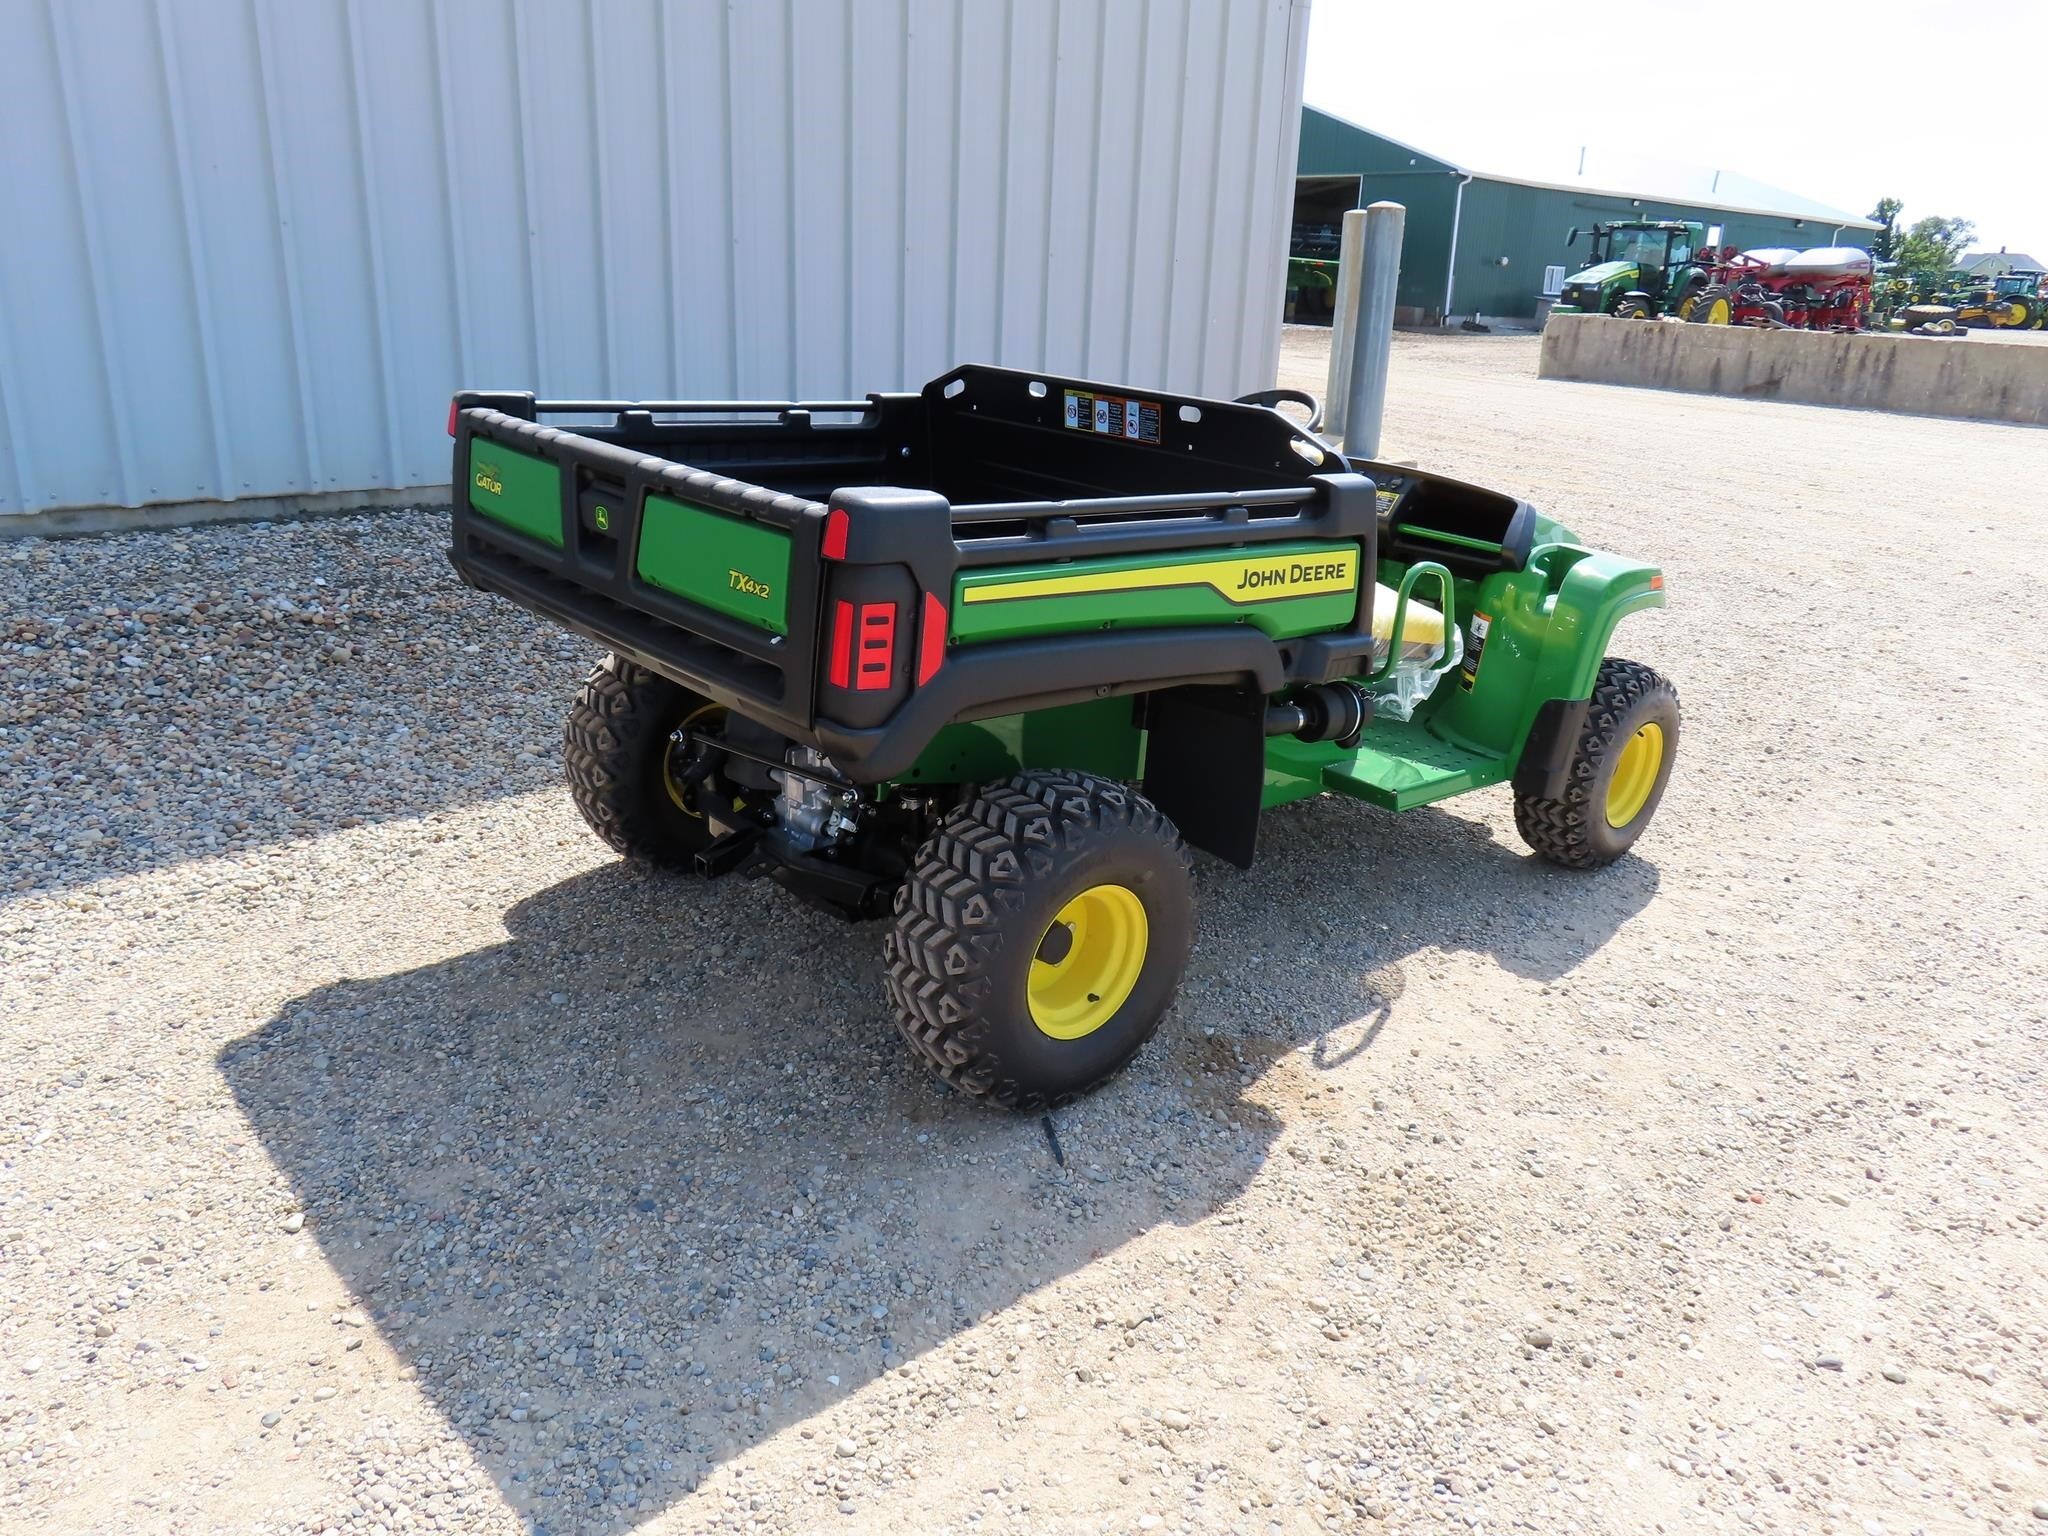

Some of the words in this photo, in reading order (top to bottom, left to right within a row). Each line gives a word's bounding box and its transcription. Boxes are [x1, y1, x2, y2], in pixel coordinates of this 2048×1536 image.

[476, 473, 502, 495] GATOR
[1237, 569, 1286, 589] JOHN
[1290, 563, 1346, 583] DEERE
